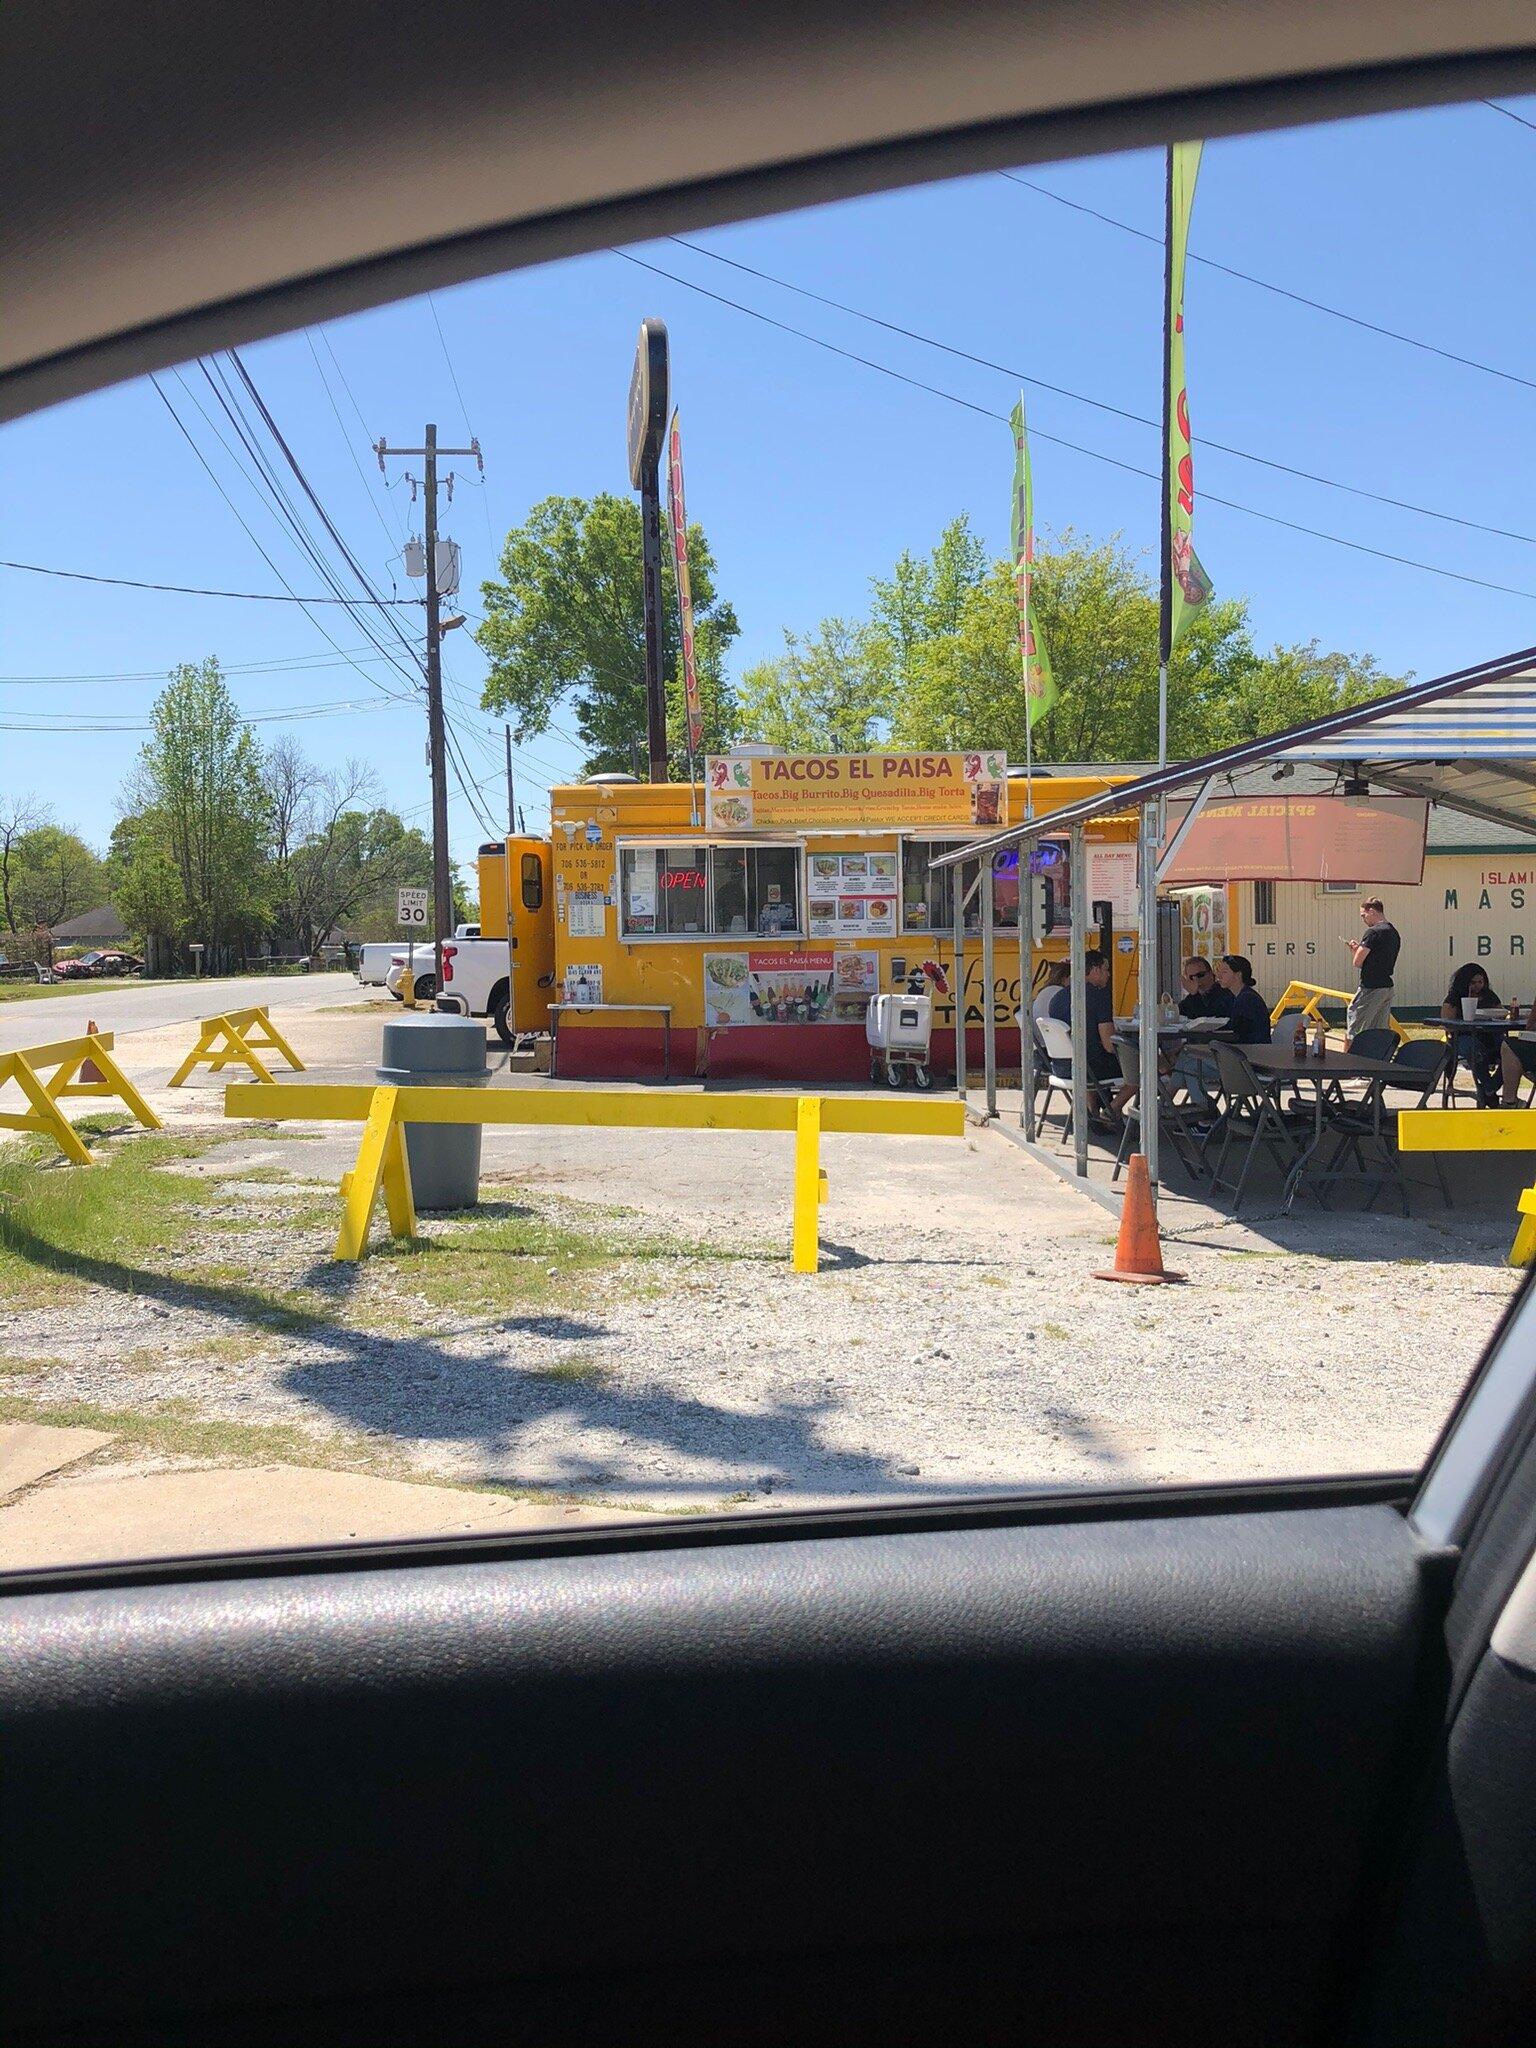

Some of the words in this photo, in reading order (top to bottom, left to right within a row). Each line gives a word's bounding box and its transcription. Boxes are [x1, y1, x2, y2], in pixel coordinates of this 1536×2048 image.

[760, 759, 840, 780] TACOS
[849, 759, 874, 779] EL
[882, 757, 953, 779] PAISA
[938, 786, 965, 798] Torta
[556, 842, 567, 851] FOR
[595, 842, 613, 851] ORDER
[561, 859, 573, 868] 706
[580, 870, 588, 879] OR
[660, 872, 706, 889] OPEN
[1481, 871, 1534, 885] ISLAMI
[400, 891, 427, 900] SPEED
[1445, 888, 1525, 910] MAS
[400, 907, 425, 922] 30
[1247, 942, 1316, 956] TERS
[1449, 934, 1525, 956] IBR
[779, 957, 788, 965] EL
[789, 957, 809, 965] PAISA
[810, 956, 832, 965] MENU
[935, 1004, 1021, 1024] TAC
